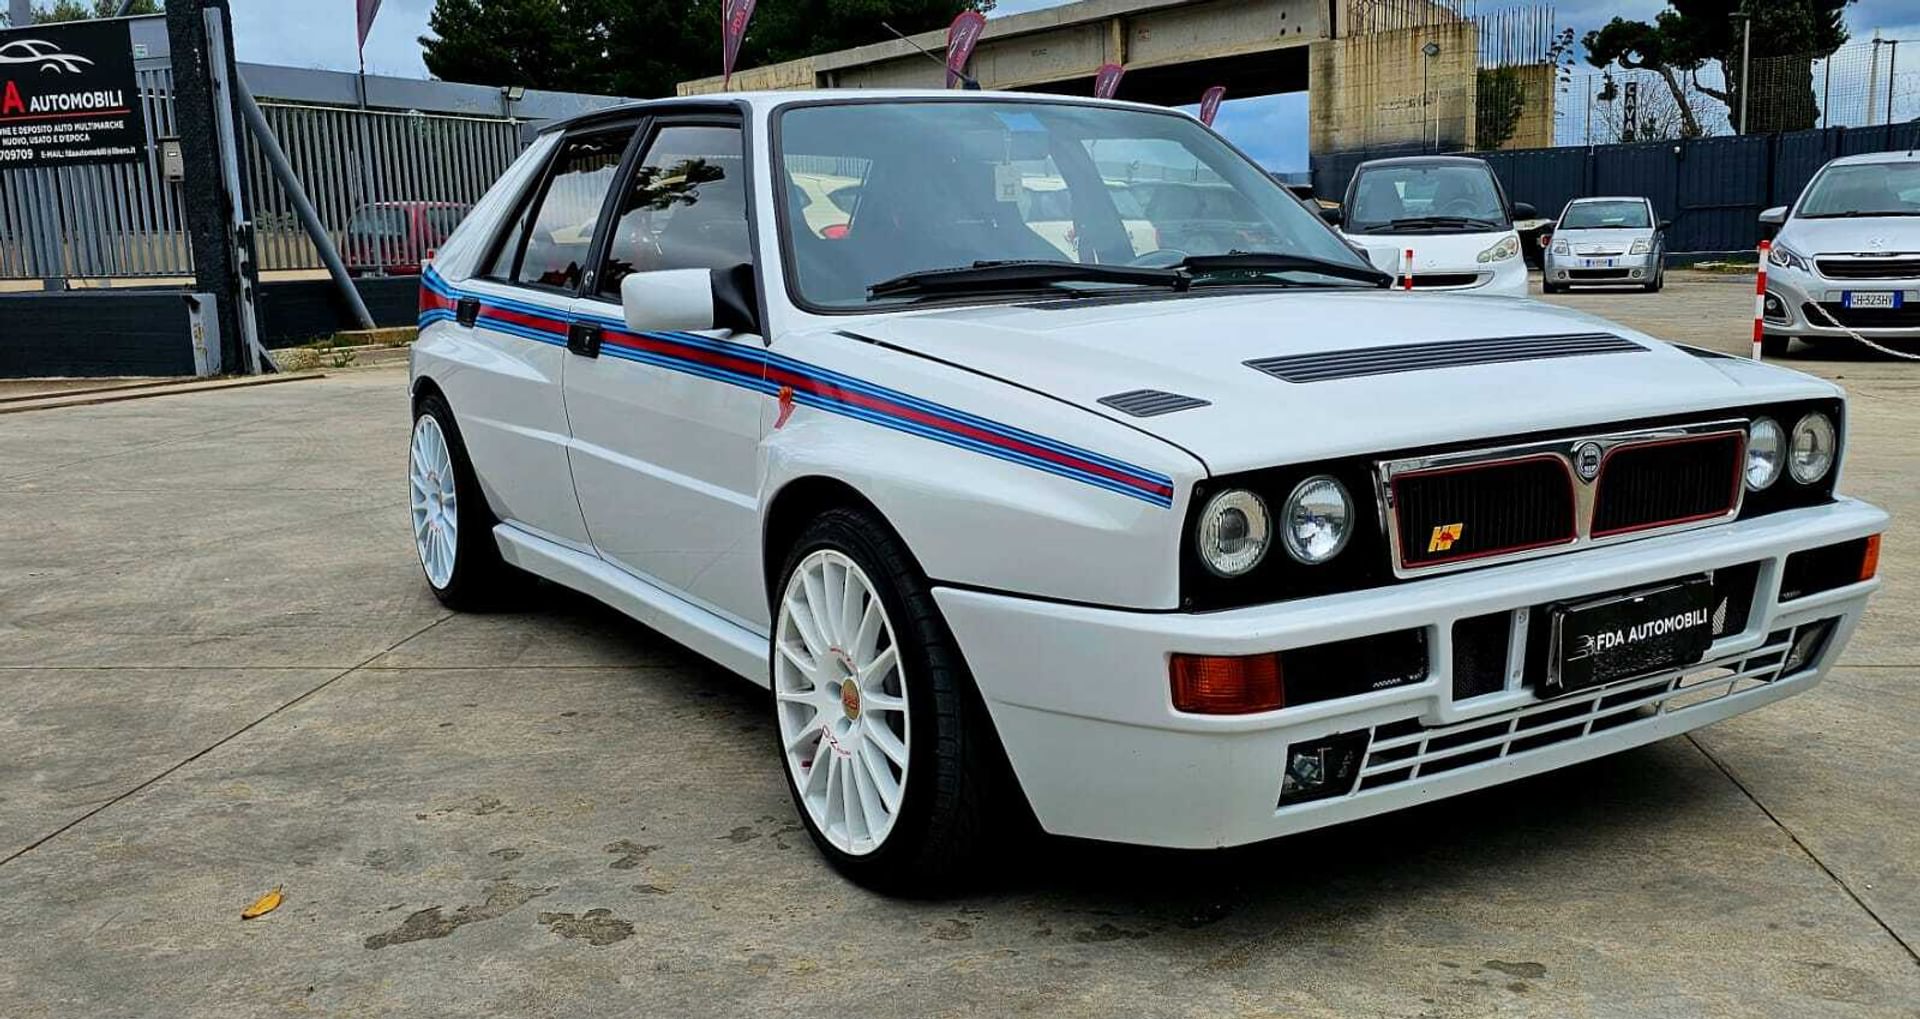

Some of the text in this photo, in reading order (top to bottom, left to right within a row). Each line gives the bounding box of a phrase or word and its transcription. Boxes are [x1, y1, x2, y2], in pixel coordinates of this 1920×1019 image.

[30, 89, 123, 112] AUTOMOBILI
[18, 124, 53, 135] DEPOSITO
[54, 123, 73, 132] AUTO
[74, 120, 124, 131] MULTIMARCHE
[29, 134, 52, 144] USATO
[1597, 607, 1708, 651] FDA AUTOMOBILI
